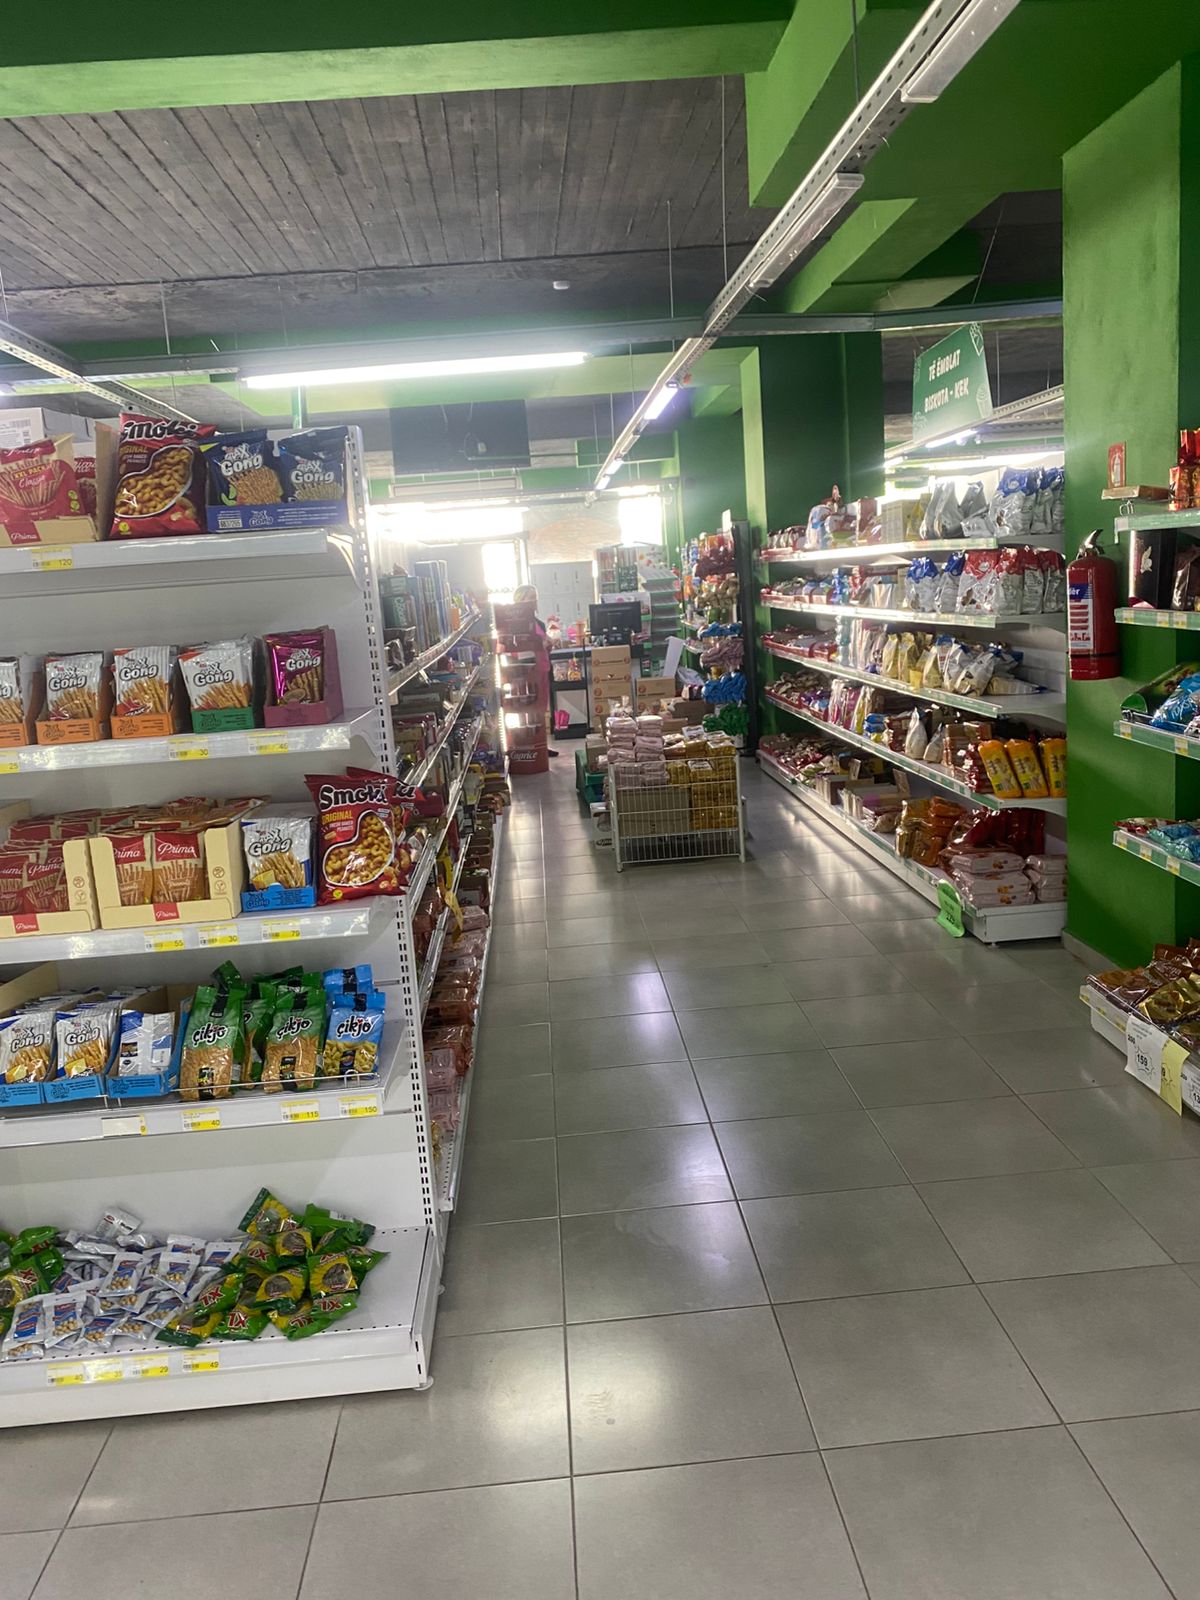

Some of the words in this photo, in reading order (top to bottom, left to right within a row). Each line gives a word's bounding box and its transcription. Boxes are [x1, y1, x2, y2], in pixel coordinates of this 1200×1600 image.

[954, 376, 969, 399] KEK
[221, 454, 263, 476] Gong
[291, 470, 335, 484] Gong
[58, 559, 73, 567] 120
[286, 656, 321, 672] Gong
[119, 665, 159, 681] Gong
[193, 669, 235, 687] Gong
[49, 675, 88, 691] Gong
[322, 810, 353, 825] ORIGINAL
[158, 842, 195, 855] Prima
[248, 837, 293, 857] Gong
[336, 1015, 373, 1039] çikjo
[11, 1034, 45, 1053] Gong
[64, 1026, 100, 1046] Gong
[1137, 1054, 1148, 1067] 159
[306, 1110, 319, 1118] 115
[364, 1105, 378, 1113] 150
